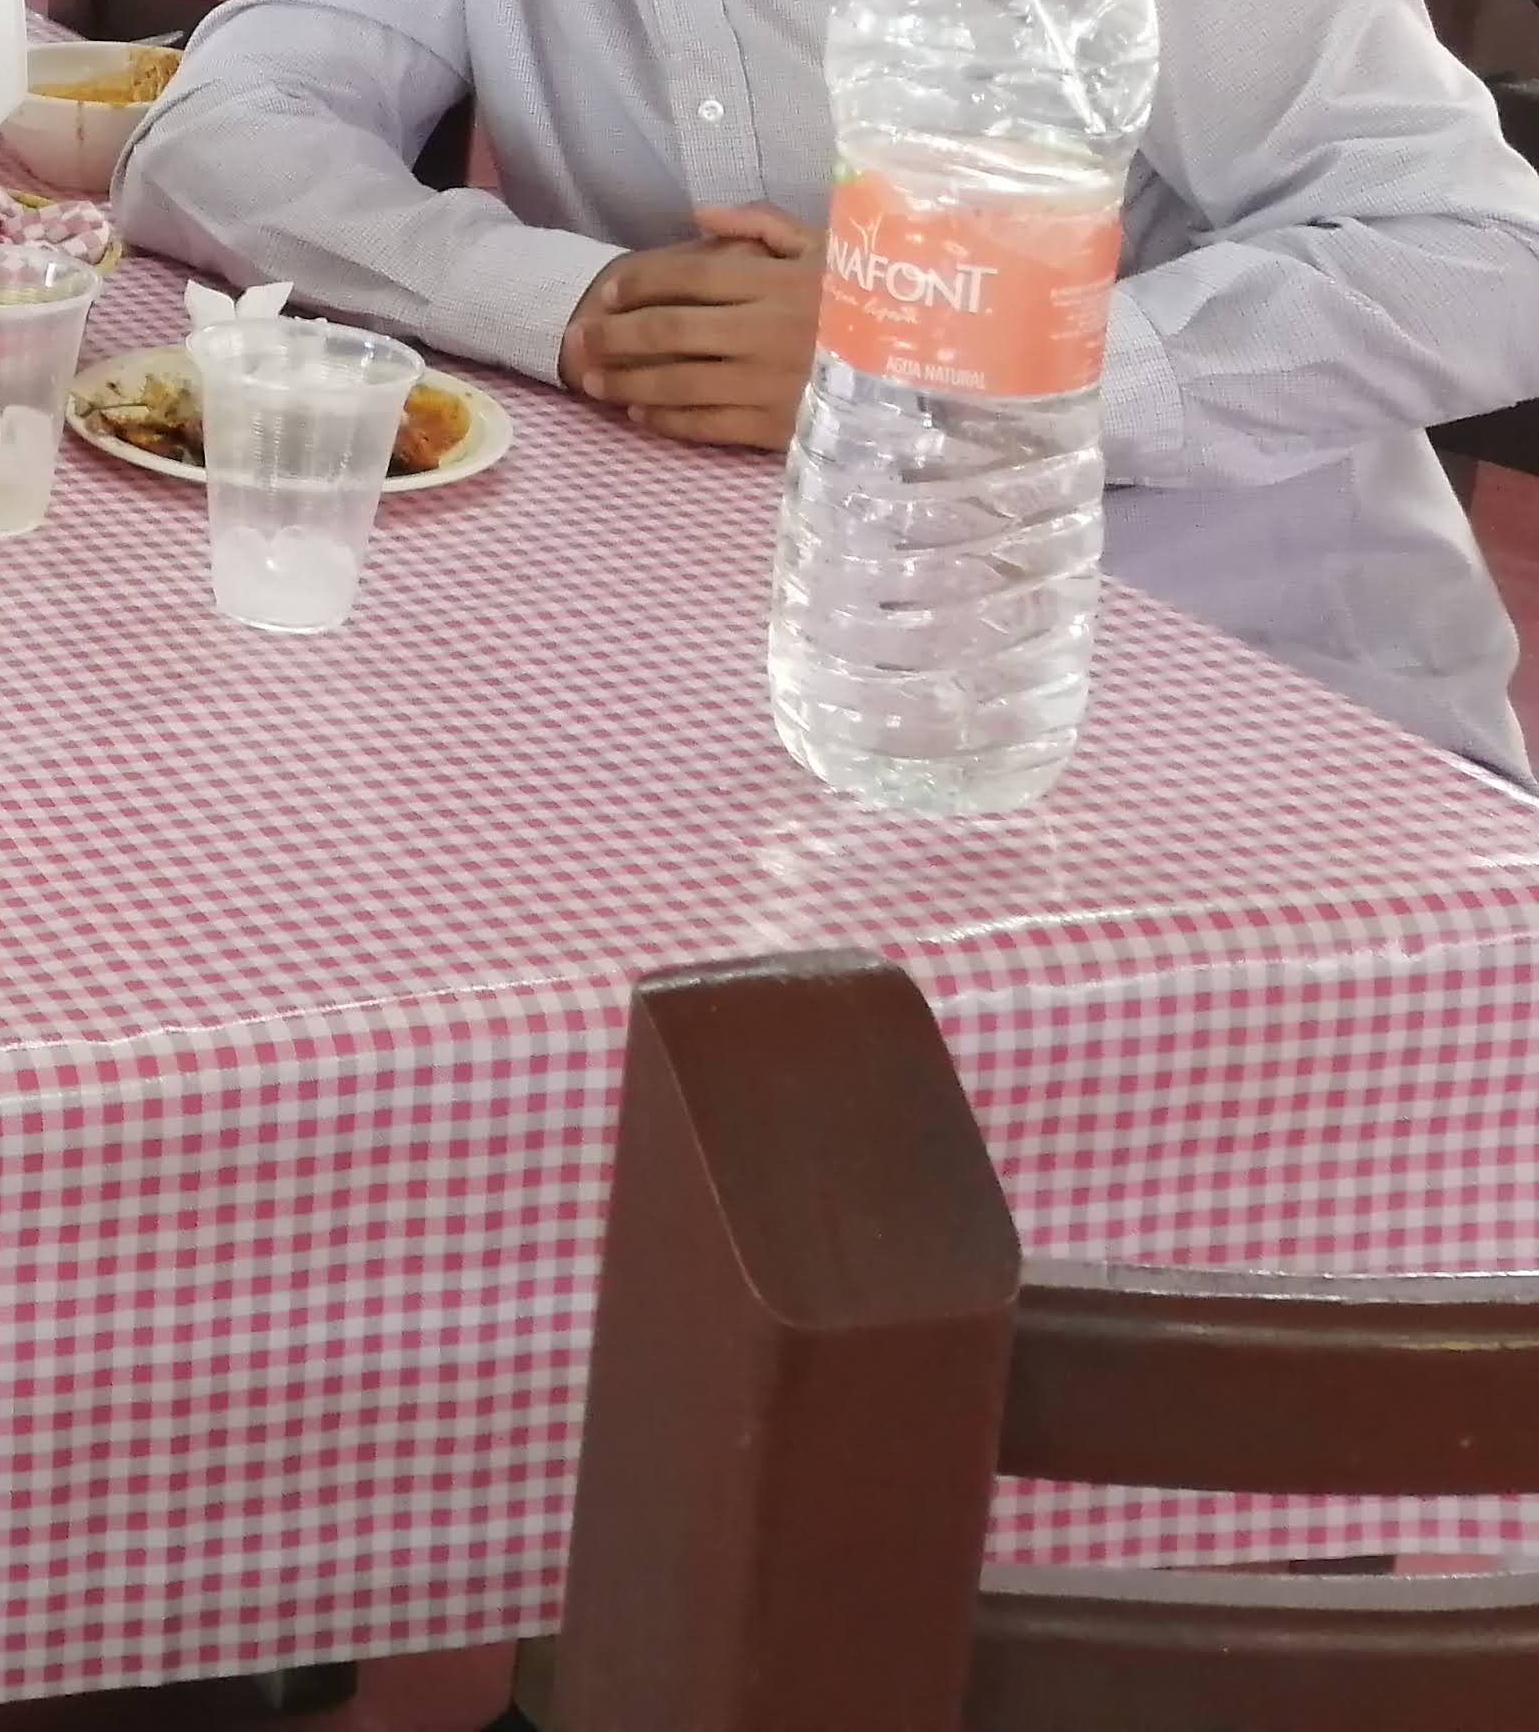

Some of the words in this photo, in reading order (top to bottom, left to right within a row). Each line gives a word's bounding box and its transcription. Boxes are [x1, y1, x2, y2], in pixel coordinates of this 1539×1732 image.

[826, 228, 998, 314] NAFONT
[884, 355, 921, 379] AGUA
[924, 364, 986, 390] NATURAL
